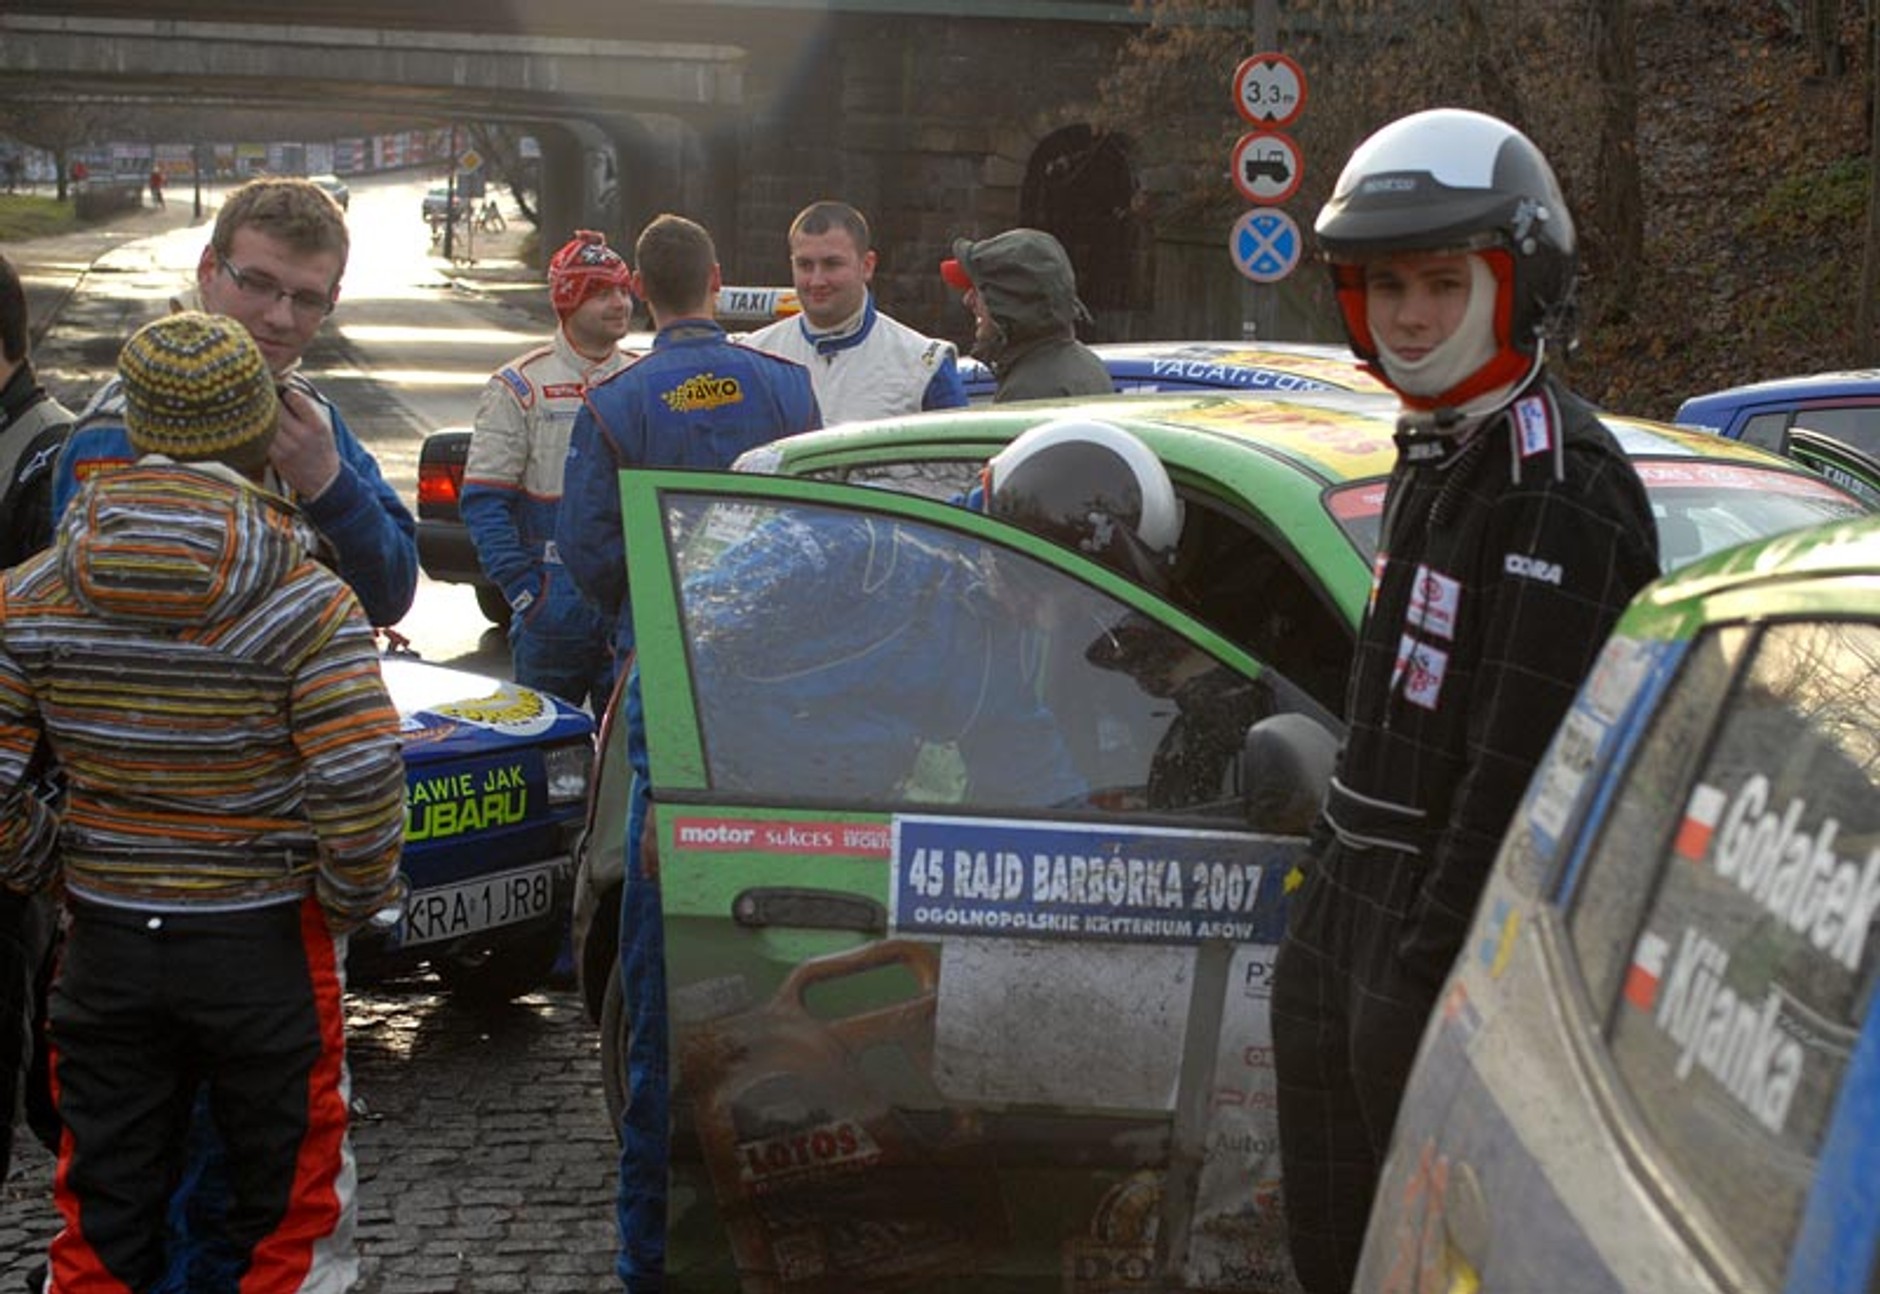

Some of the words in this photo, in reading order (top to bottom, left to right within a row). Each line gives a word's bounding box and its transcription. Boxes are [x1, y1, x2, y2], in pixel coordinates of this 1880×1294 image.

[729, 291, 768, 312] TAXI
[483, 764, 526, 792] JAK
[680, 825, 755, 844] motor
[909, 847, 945, 897] 45
[953, 850, 1024, 900] RAJD
[1032, 844, 1184, 909] BARBÓRKA
[1192, 860, 1263, 913] 2007
[405, 895, 469, 941] KRA
[483, 884, 548, 924] 1JR8
[914, 904, 1079, 931] OGÓLNOPOLSKIE
[1084, 914, 1193, 937] KRYTERIUM
